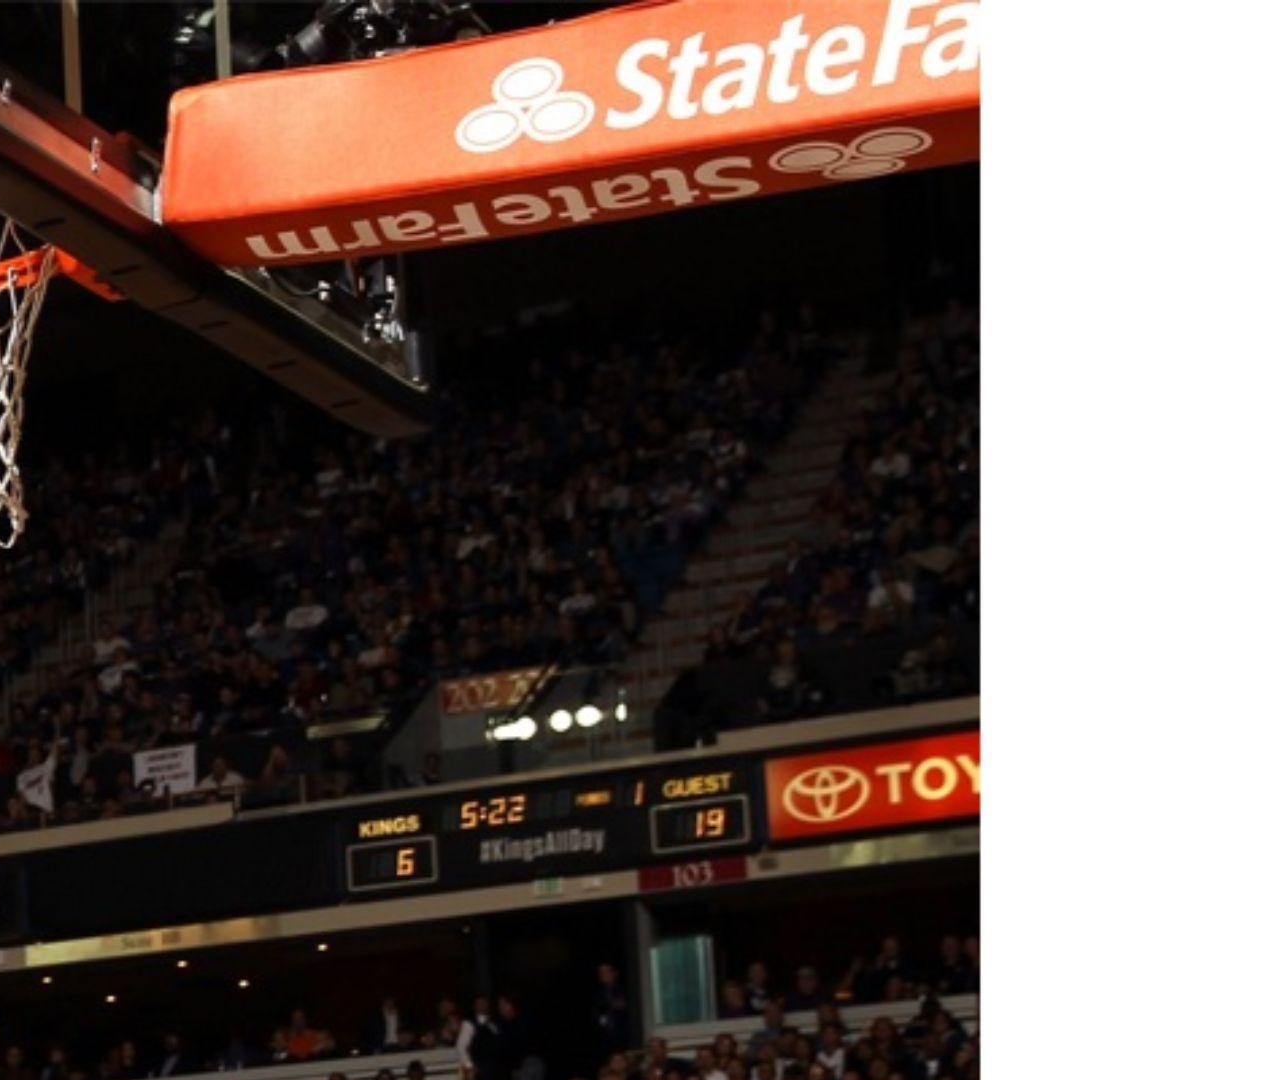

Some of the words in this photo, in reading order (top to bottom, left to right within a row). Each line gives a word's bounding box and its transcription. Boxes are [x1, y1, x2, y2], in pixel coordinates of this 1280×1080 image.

[605, 13, 866, 130] State
[662, 772, 733, 799] GUEST
[874, 753, 980, 804] TOY
[358, 814, 421, 839] KINGS
[459, 794, 527, 830] 5:22
[695, 807, 726, 838] 19
[395, 847, 416, 877] 6
[673, 861, 714, 888] 103
